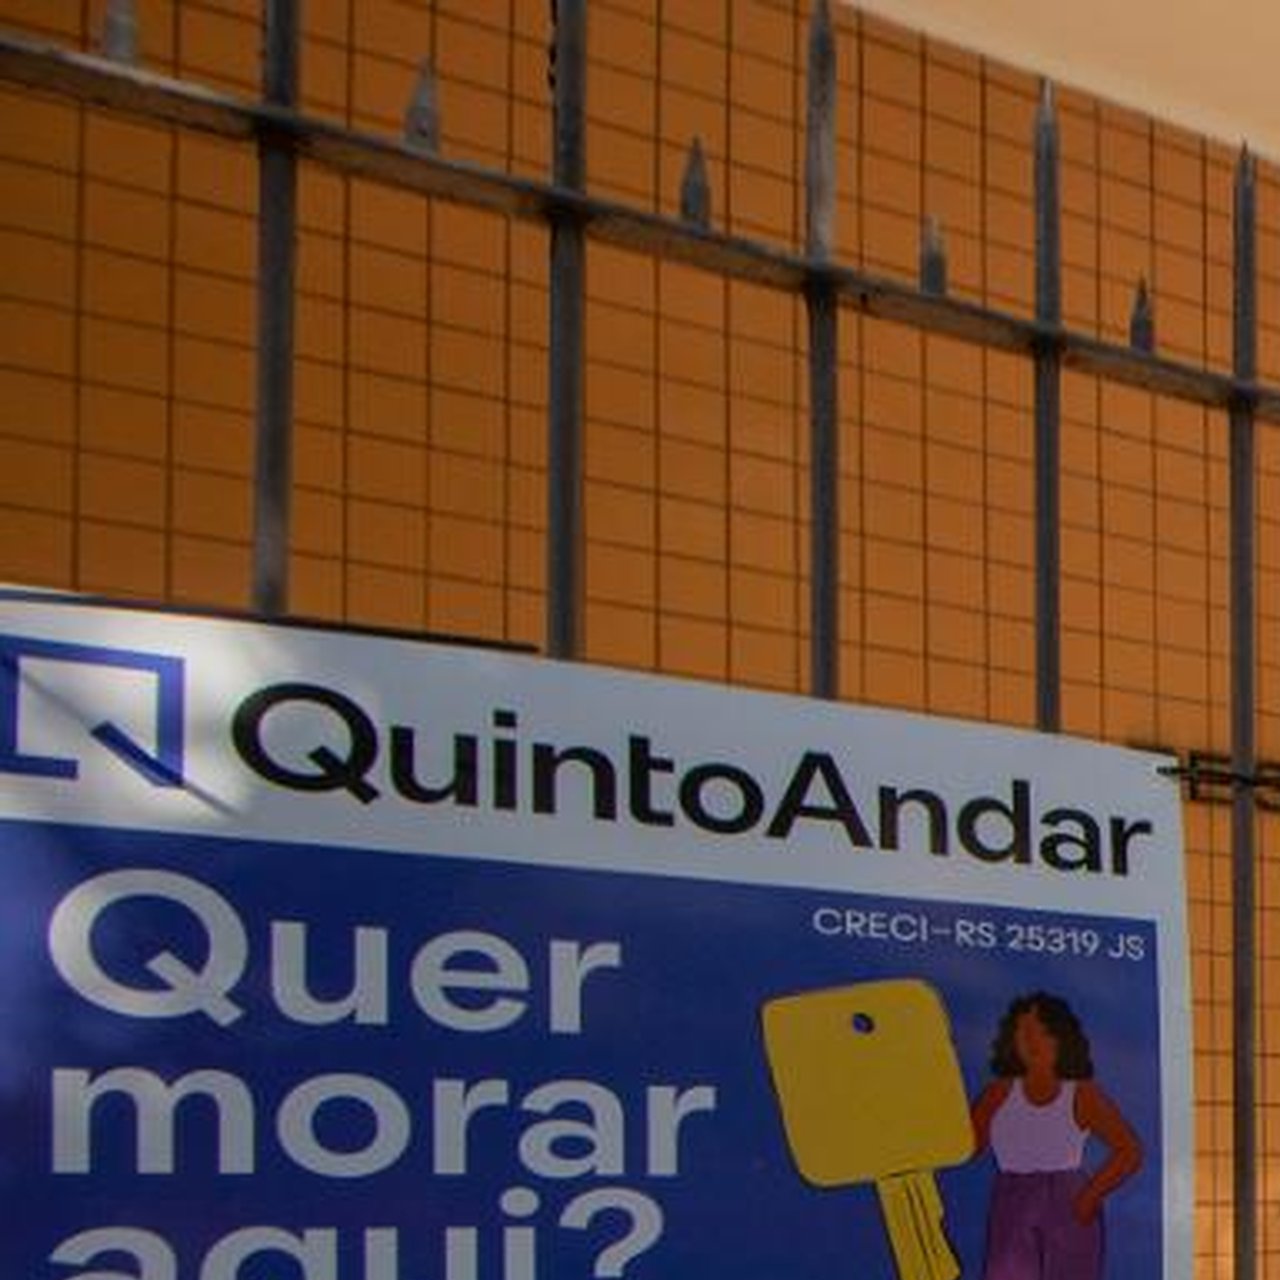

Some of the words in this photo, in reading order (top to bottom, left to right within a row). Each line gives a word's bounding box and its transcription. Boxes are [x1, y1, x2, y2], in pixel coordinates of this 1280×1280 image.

[230, 681, 1153, 878] QuintoAndar
[47, 867, 621, 1035] Quer
[812, 907, 997, 948] CRECI-RS
[1004, 923, 1100, 957] 25319
[1108, 934, 1145, 961] JS
[49, 1066, 719, 1179] morar
